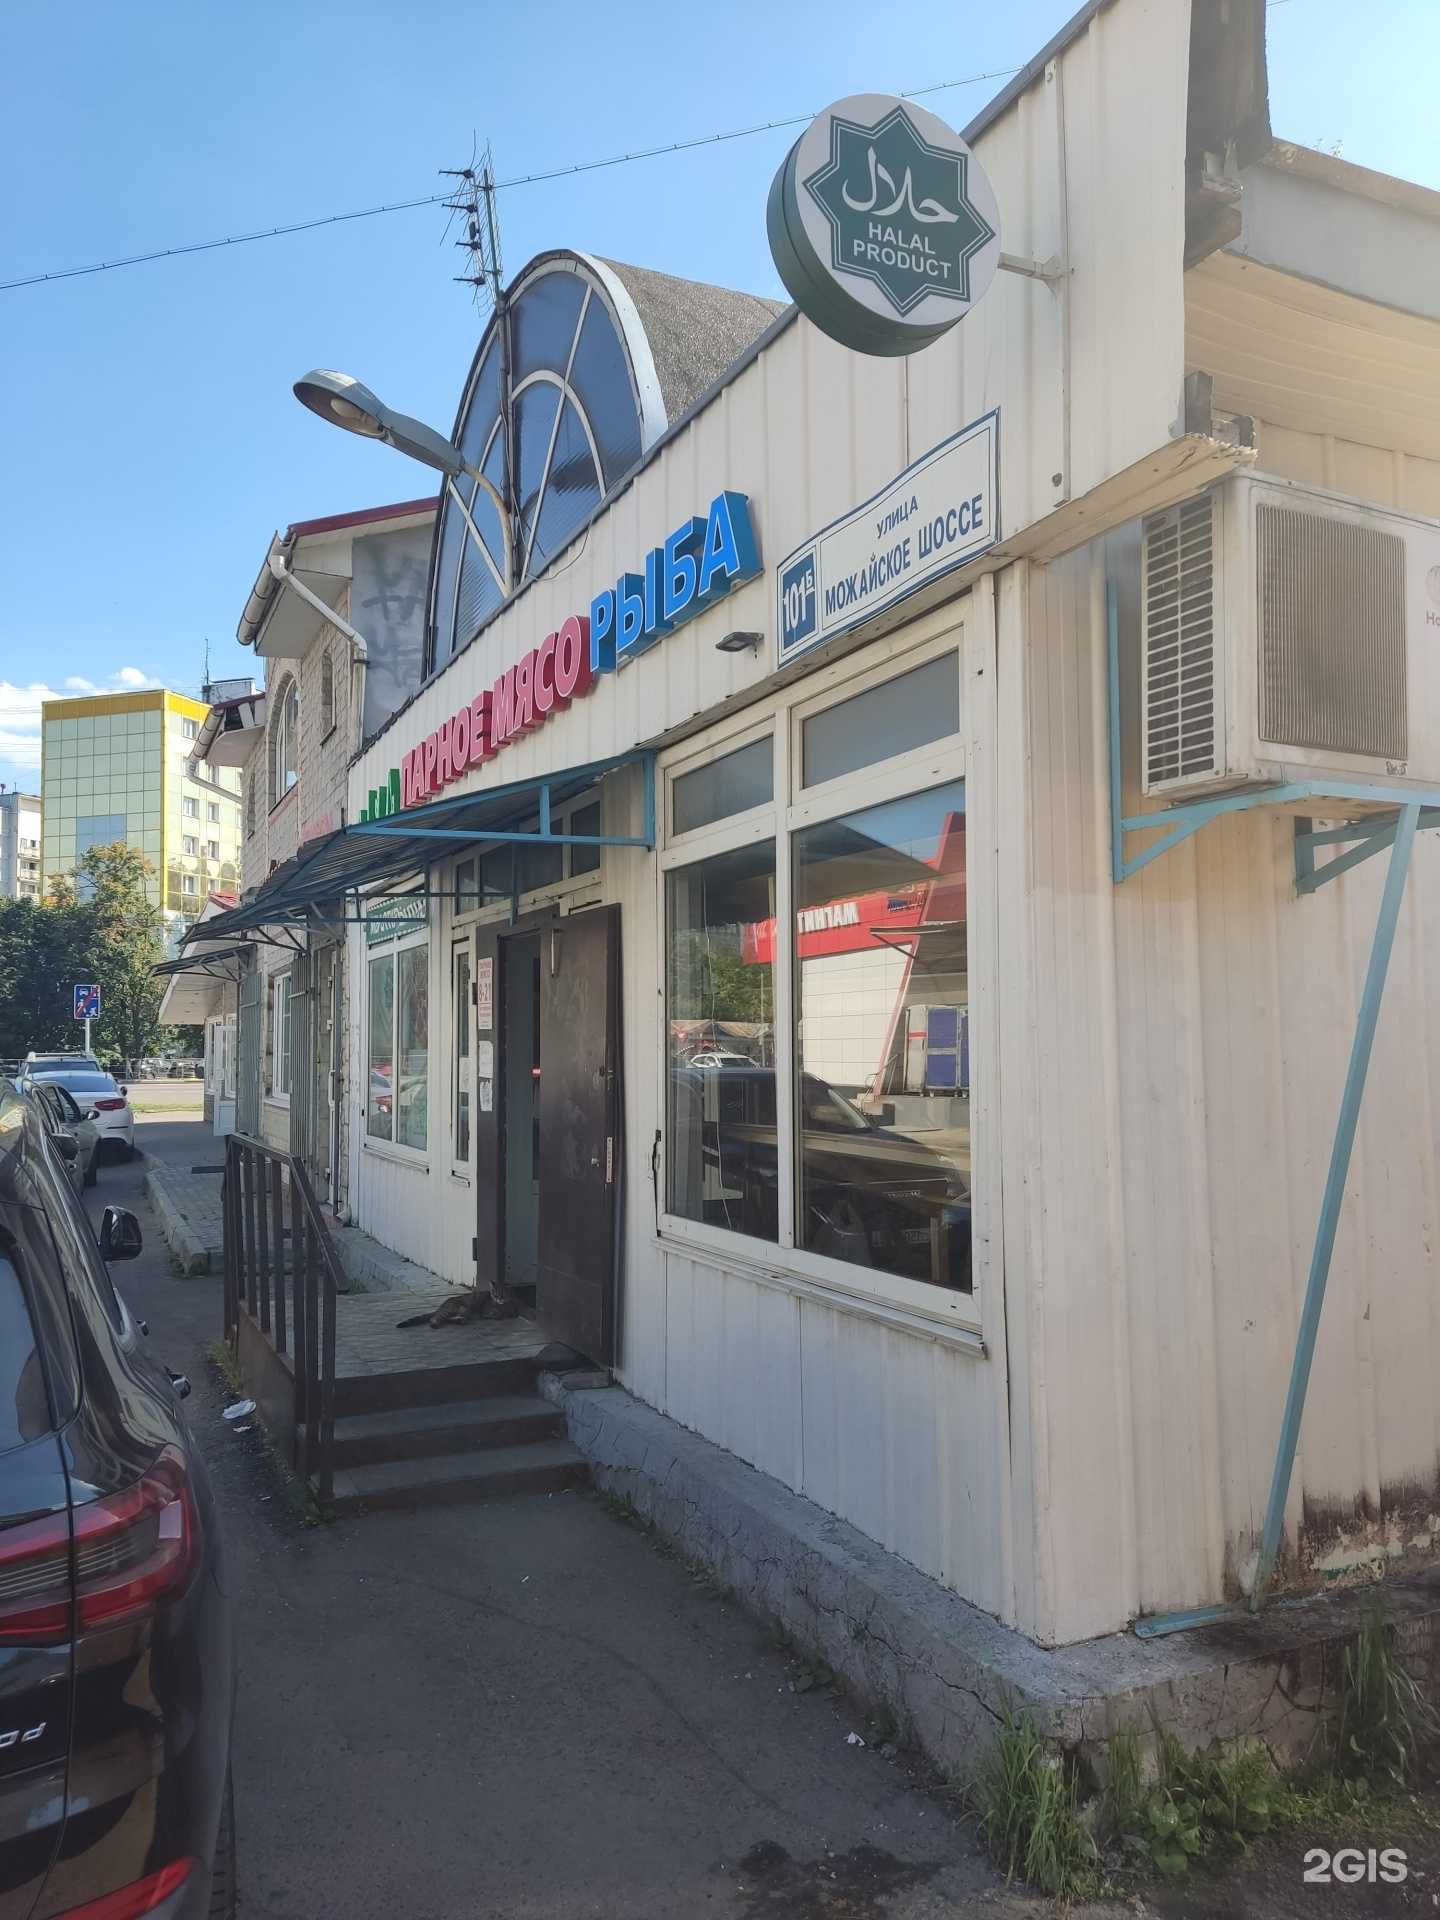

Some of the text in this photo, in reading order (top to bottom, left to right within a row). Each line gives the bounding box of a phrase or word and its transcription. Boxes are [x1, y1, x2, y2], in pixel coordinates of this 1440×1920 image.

[842, 145, 959, 223] حلال
[853, 239, 951, 279] PRODUCT
[868, 221, 936, 255] HALAL
[876, 495, 918, 539] УЛИЦА
[825, 493, 984, 617] МОЖАЙСКОЕ ШОССЕ
[402, 688, 490, 808] ПАРНОЕ
[491, 614, 588, 750] МЯСО
[590, 489, 748, 673] РЫБА
